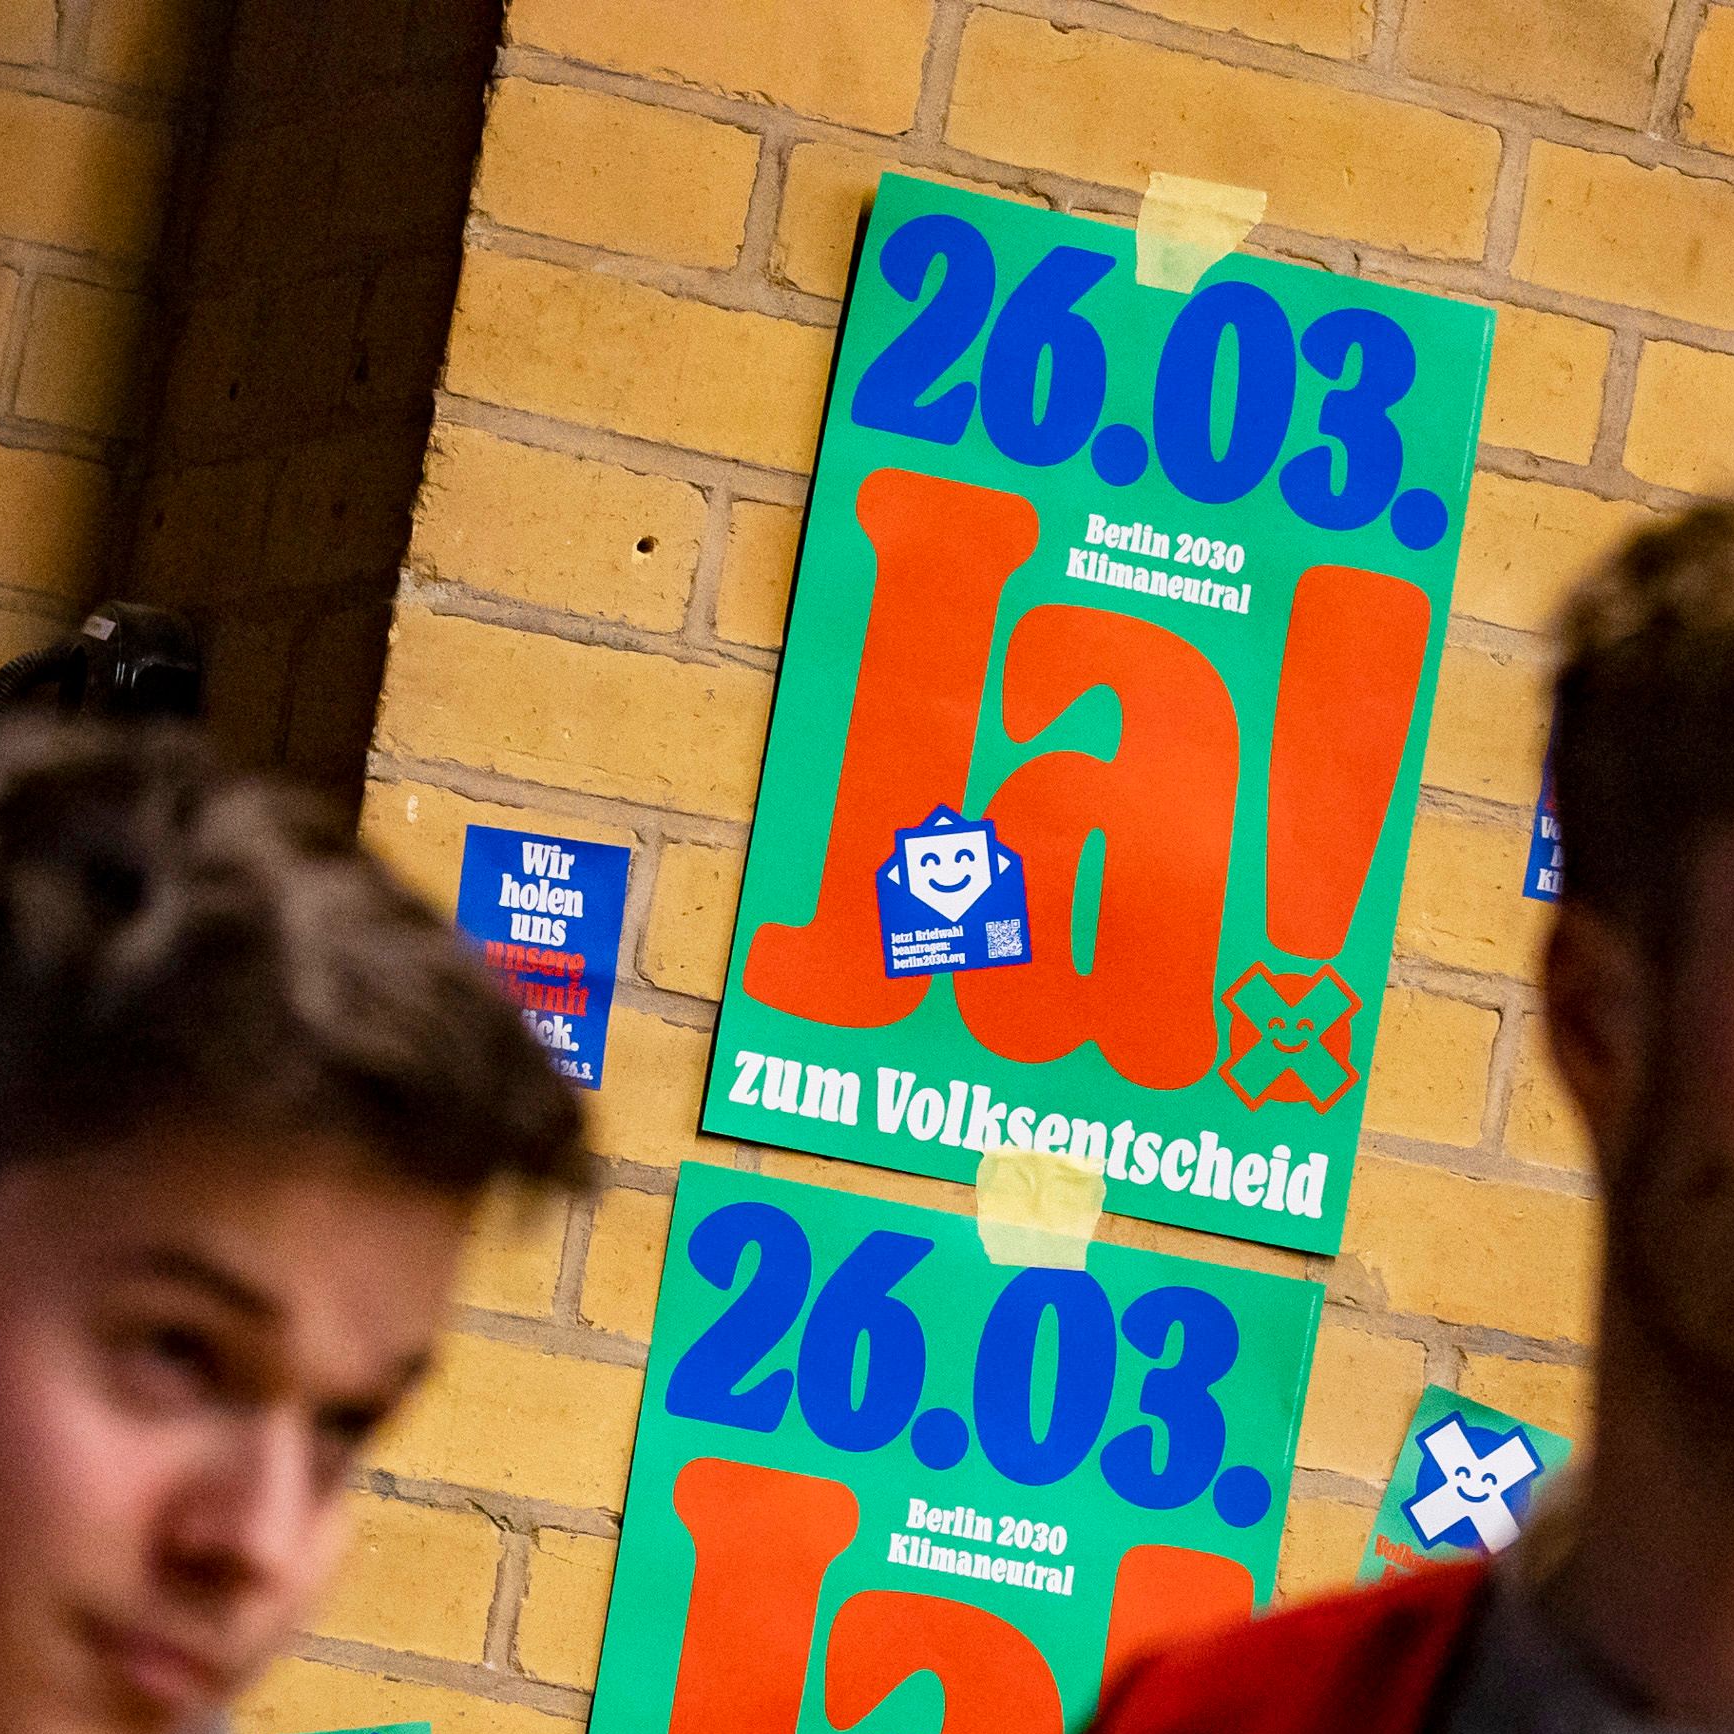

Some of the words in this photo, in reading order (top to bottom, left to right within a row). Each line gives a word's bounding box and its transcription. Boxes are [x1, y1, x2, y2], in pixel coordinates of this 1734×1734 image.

[851, 214, 1449, 551] 26.03.
[1084, 513, 1170, 560] Berlin
[1173, 533, 1245, 574] 2030
[1065, 547, 1252, 615] Klimaneutral
[742, 468, 1431, 1092] Ja!
[522, 841, 575, 880] Wir
[498, 873, 584, 918] holen
[510, 912, 566, 947] uns
[891, 931, 913, 944] Jetzt
[915, 925, 964, 942] Briefwahl
[892, 941, 951, 957] beantragen:
[485, 940, 585, 979] unsere
[893, 952, 966, 970] berlin2030.org
[728, 1050, 862, 1126] zum
[876, 1066, 1330, 1220] Volksentscheid
[664, 1200, 1272, 1528] 26.03.
[905, 1497, 992, 1542] Berlin
[996, 1515, 1068, 1556] 2030
[886, 1532, 1075, 1596] Klimaneutral
